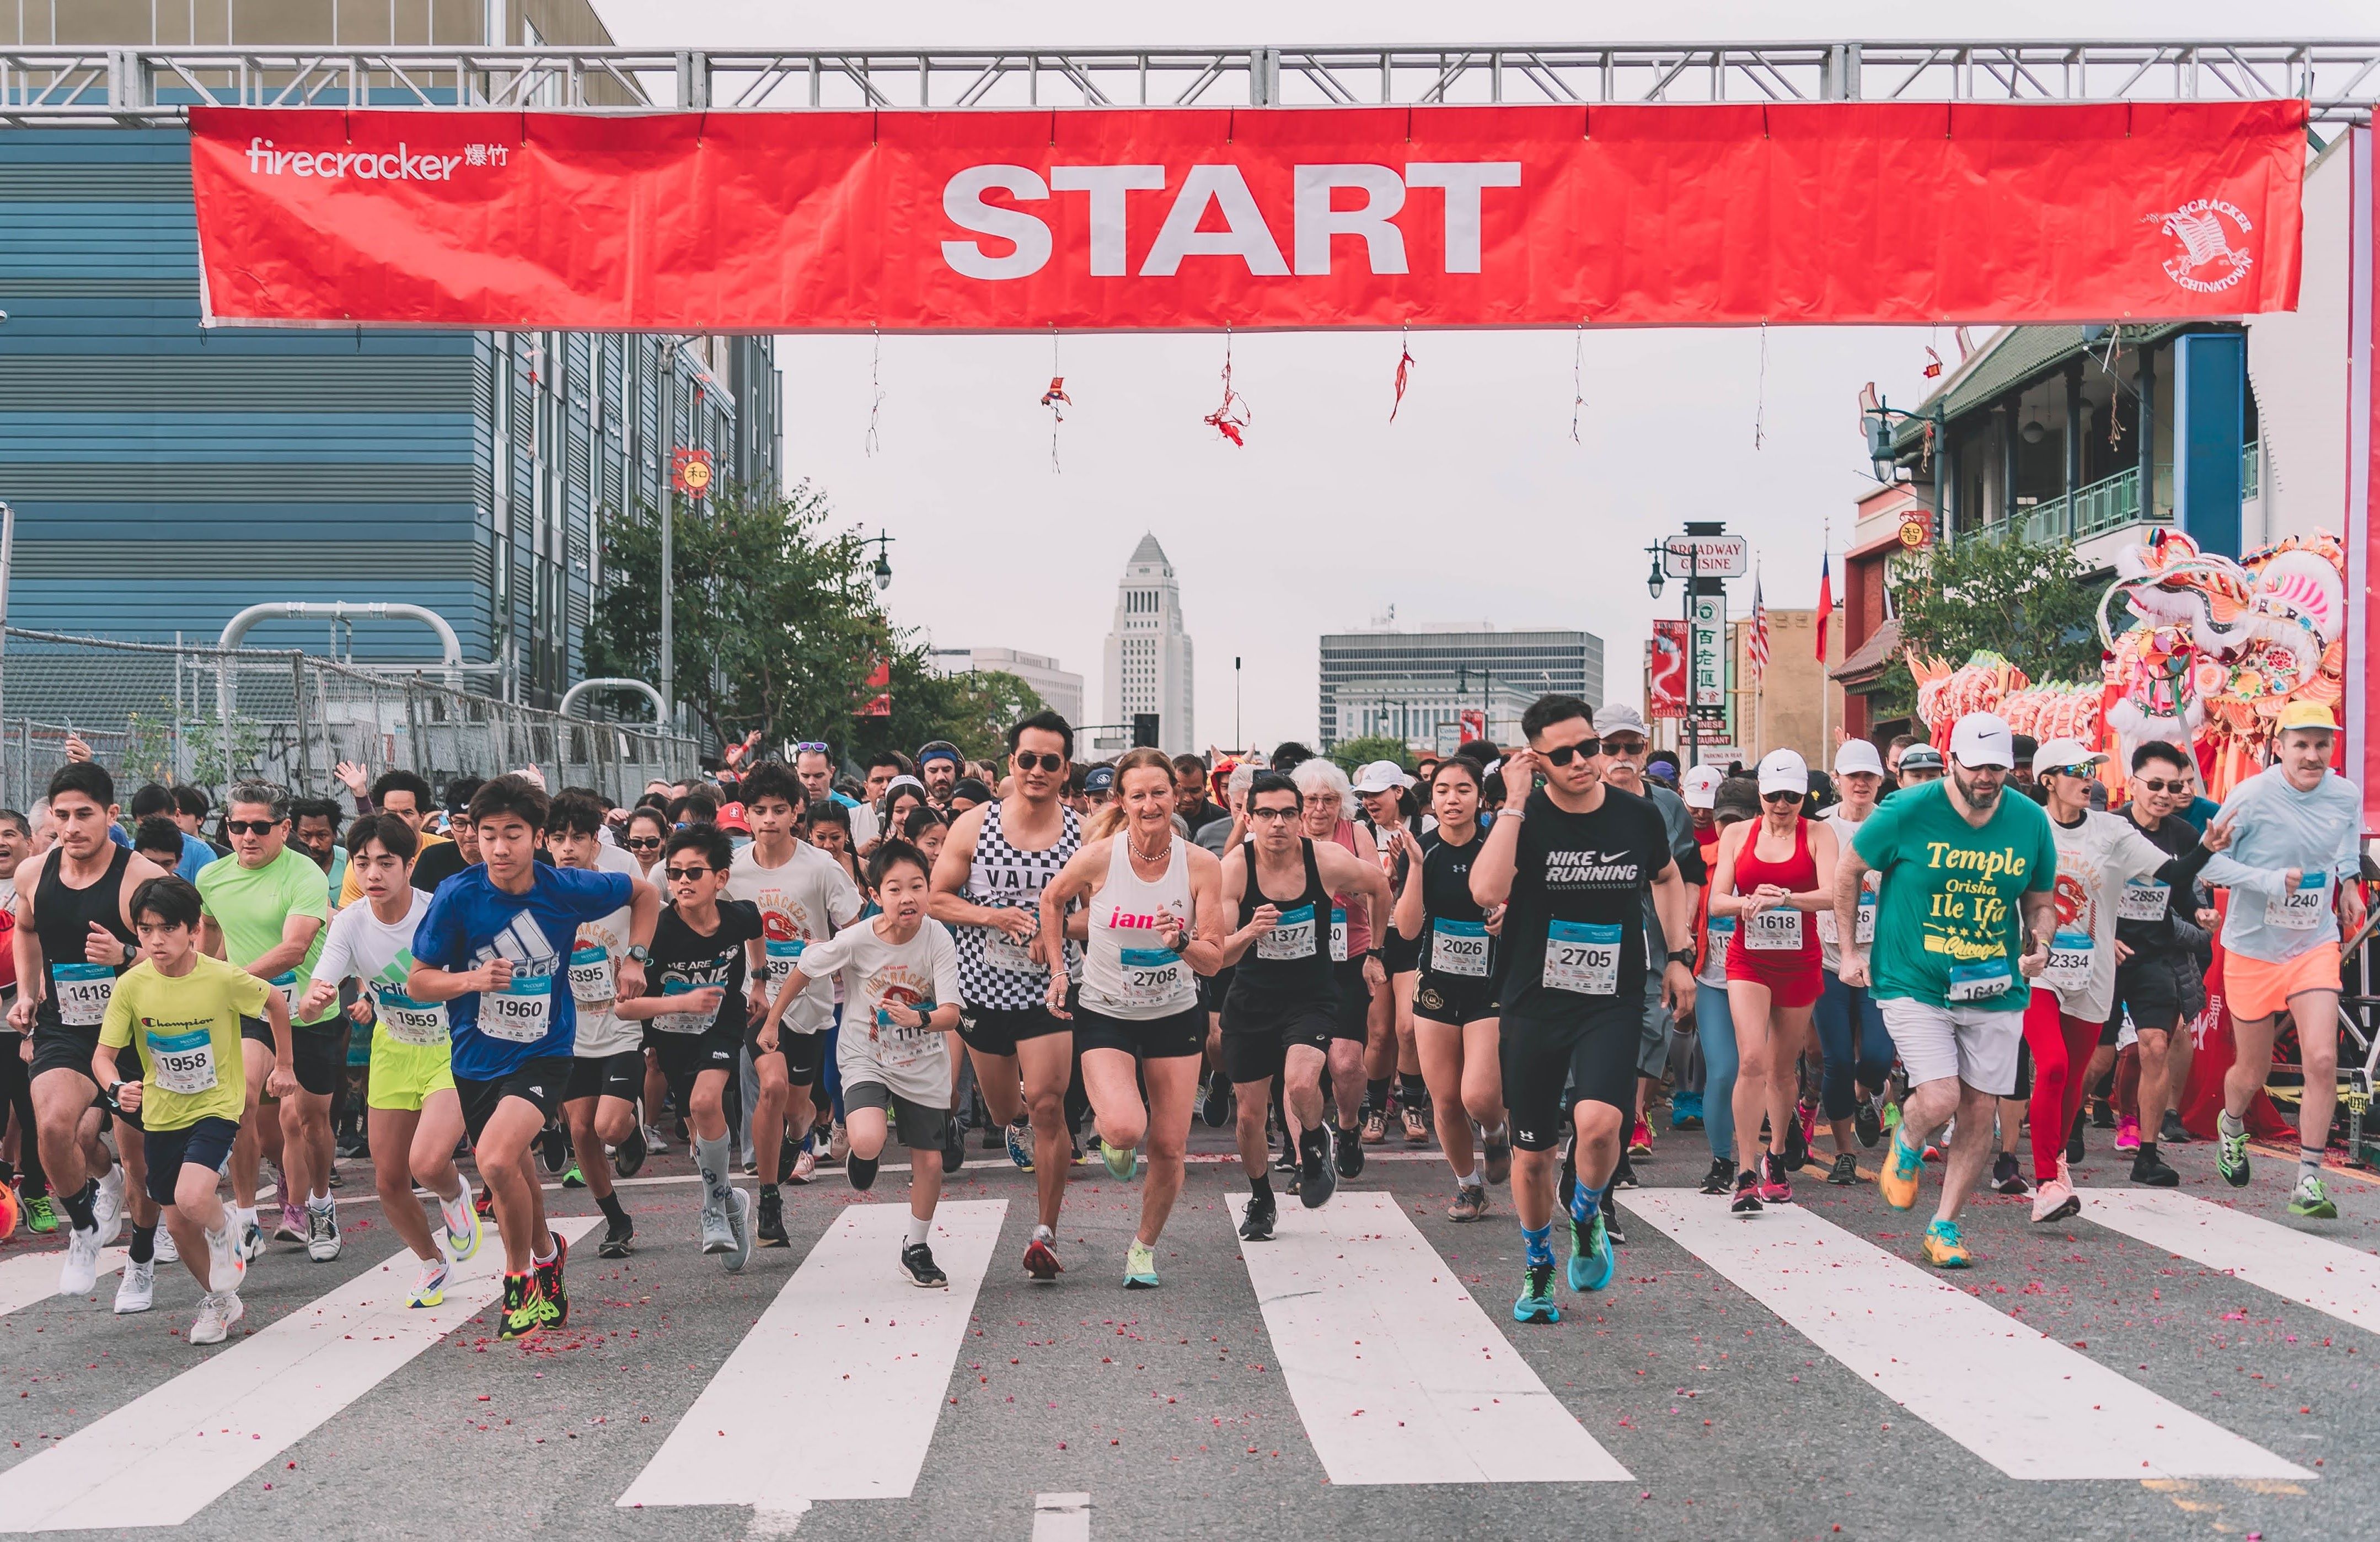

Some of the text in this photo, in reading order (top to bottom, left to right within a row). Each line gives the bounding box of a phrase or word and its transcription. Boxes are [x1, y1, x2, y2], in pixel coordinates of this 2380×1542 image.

[246, 137, 463, 182] firecracker
[464, 143, 510, 168] 爆竹
[941, 162, 1521, 280] START
[2179, 256, 2254, 293] CHINATOWN
[687, 466, 707, 482] 和
[1902, 526, 1920, 542] 智
[1681, 558, 1731, 569] CISINE
[1686, 720, 1725, 729] CINESE
[1681, 736, 1730, 744] RETAURANT
[1546, 851, 1596, 866] NIKE
[1927, 842, 2025, 881] Temple
[1545, 865, 1638, 882] RUNNING
[1945, 879, 1997, 895] Orisha
[1929, 893, 2007, 930] Ile Ifa
[1758, 915, 1795, 930] 1618
[1269, 926, 1309, 942] 1377
[1443, 939, 1483, 955] 2026
[1943, 936, 2000, 960] Chicago
[668, 960, 712, 971] WE ARE
[1560, 948, 1611, 968] 2705
[1134, 967, 1177, 987] 2708
[70, 984, 111, 1001] 1418
[496, 1000, 543, 1018] 1960
[141, 1018, 215, 1030] Champion
[396, 1012, 438, 1028] 1959
[162, 1052, 207, 1072] 1958
